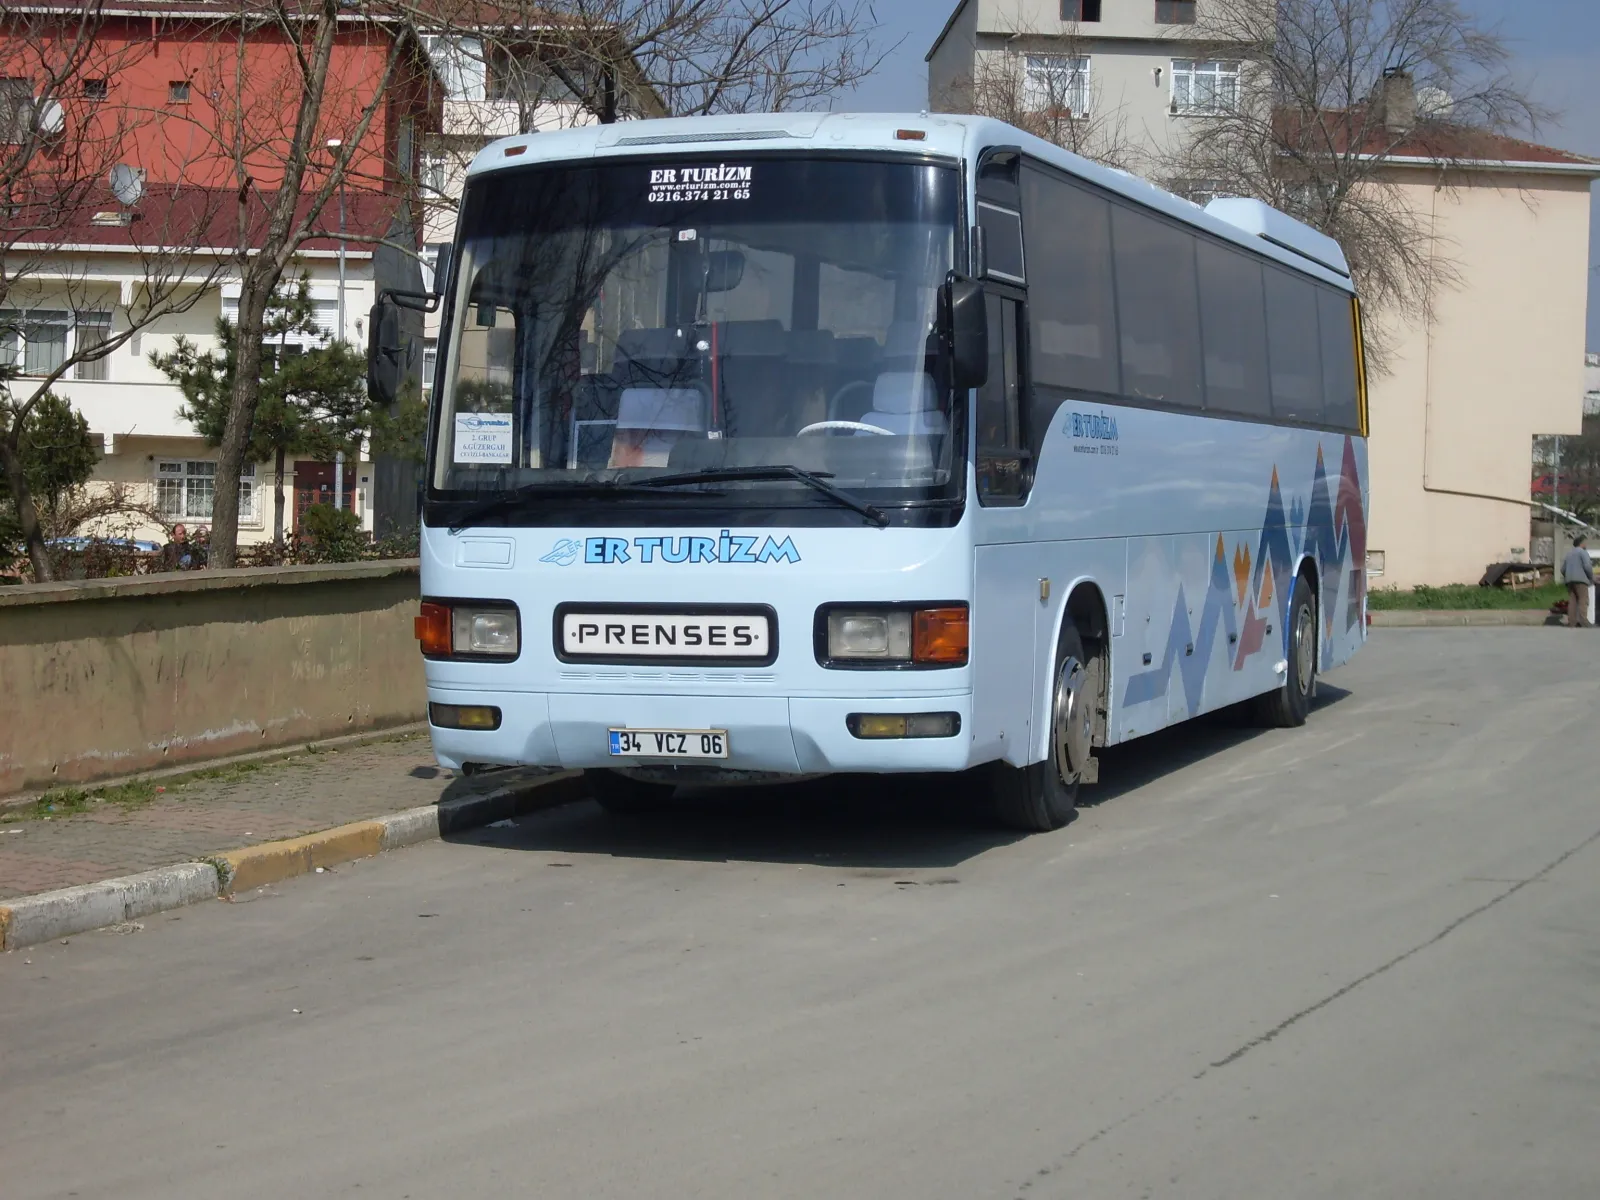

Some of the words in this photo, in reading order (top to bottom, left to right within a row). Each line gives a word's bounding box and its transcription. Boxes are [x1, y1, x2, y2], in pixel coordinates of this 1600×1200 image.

[650, 169, 677, 183] ER
[681, 163, 752, 182] TURİZM
[648, 190, 708, 202] 0216.374
[713, 190, 729, 200] 21
[734, 189, 750, 199] 65
[652, 181, 751, 191] www.erturizm.com.tr
[478, 434, 497, 442] GRUP
[585, 537, 631, 564] ER
[634, 529, 802, 564] TURİZM
[578, 623, 753, 646] PRENSES
[620, 732, 642, 752] 34
[654, 734, 687, 753] VCZ
[701, 735, 722, 754] 06
